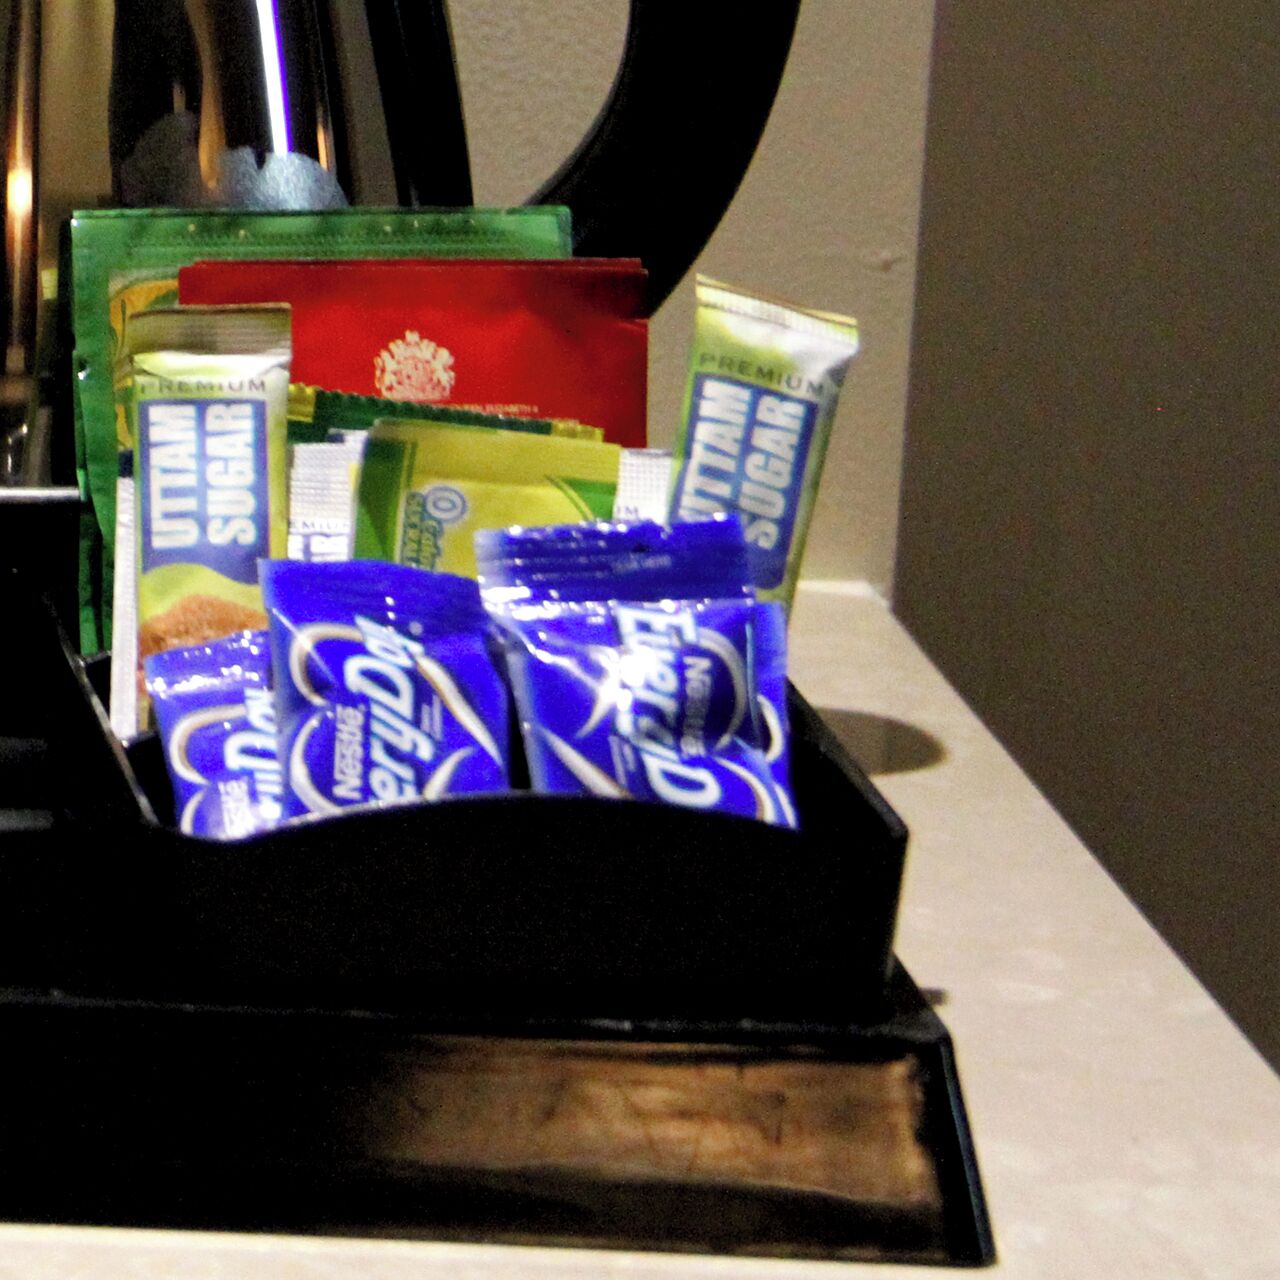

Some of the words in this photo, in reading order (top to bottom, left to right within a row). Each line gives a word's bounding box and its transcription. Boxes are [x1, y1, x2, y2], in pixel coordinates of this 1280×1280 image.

[141, 379, 266, 394] PREMIUM
[699, 353, 824, 397] PREMIUM
[148, 404, 199, 549] UTTAM
[205, 403, 256, 545] SUGAR
[740, 394, 806, 550] SUGAR
